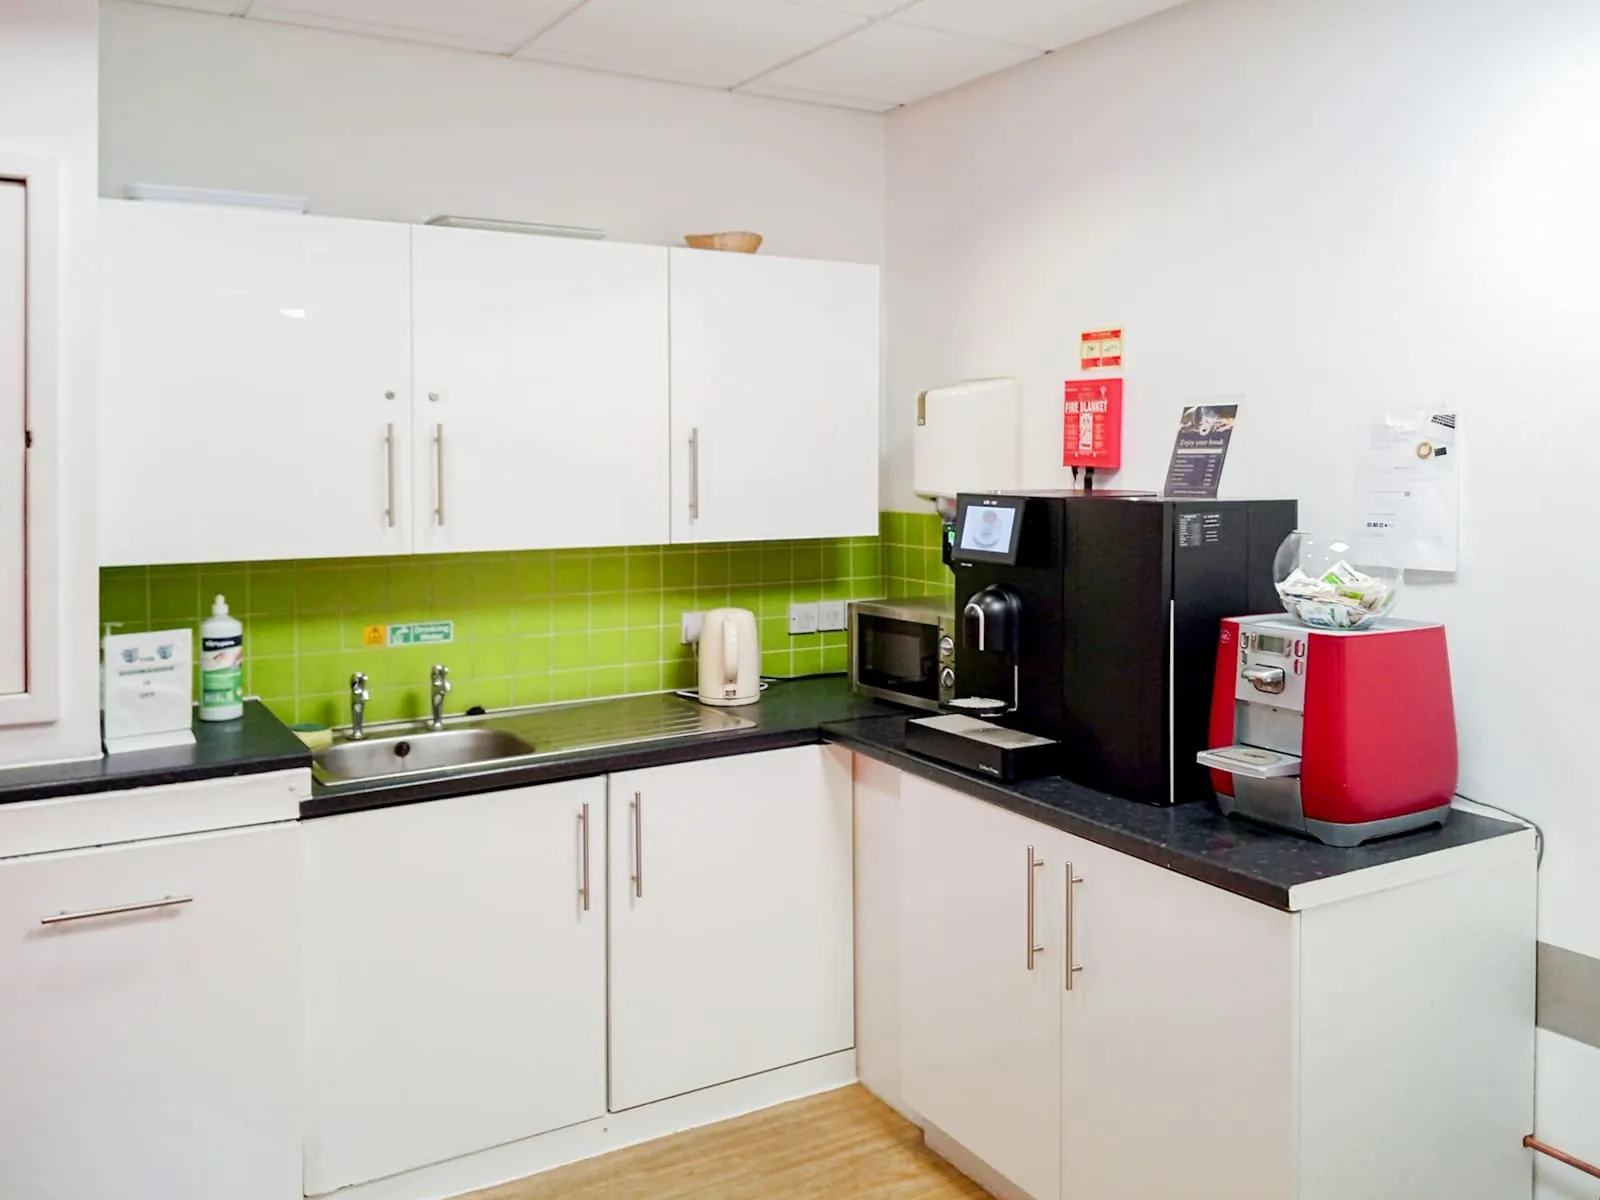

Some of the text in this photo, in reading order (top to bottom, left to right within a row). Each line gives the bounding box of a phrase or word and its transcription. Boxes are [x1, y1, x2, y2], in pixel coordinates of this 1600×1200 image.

[1065, 400, 1107, 414] FIRE BLANKET
[1180, 439, 1194, 447] Enjoy
[415, 625, 449, 634] Drinking
